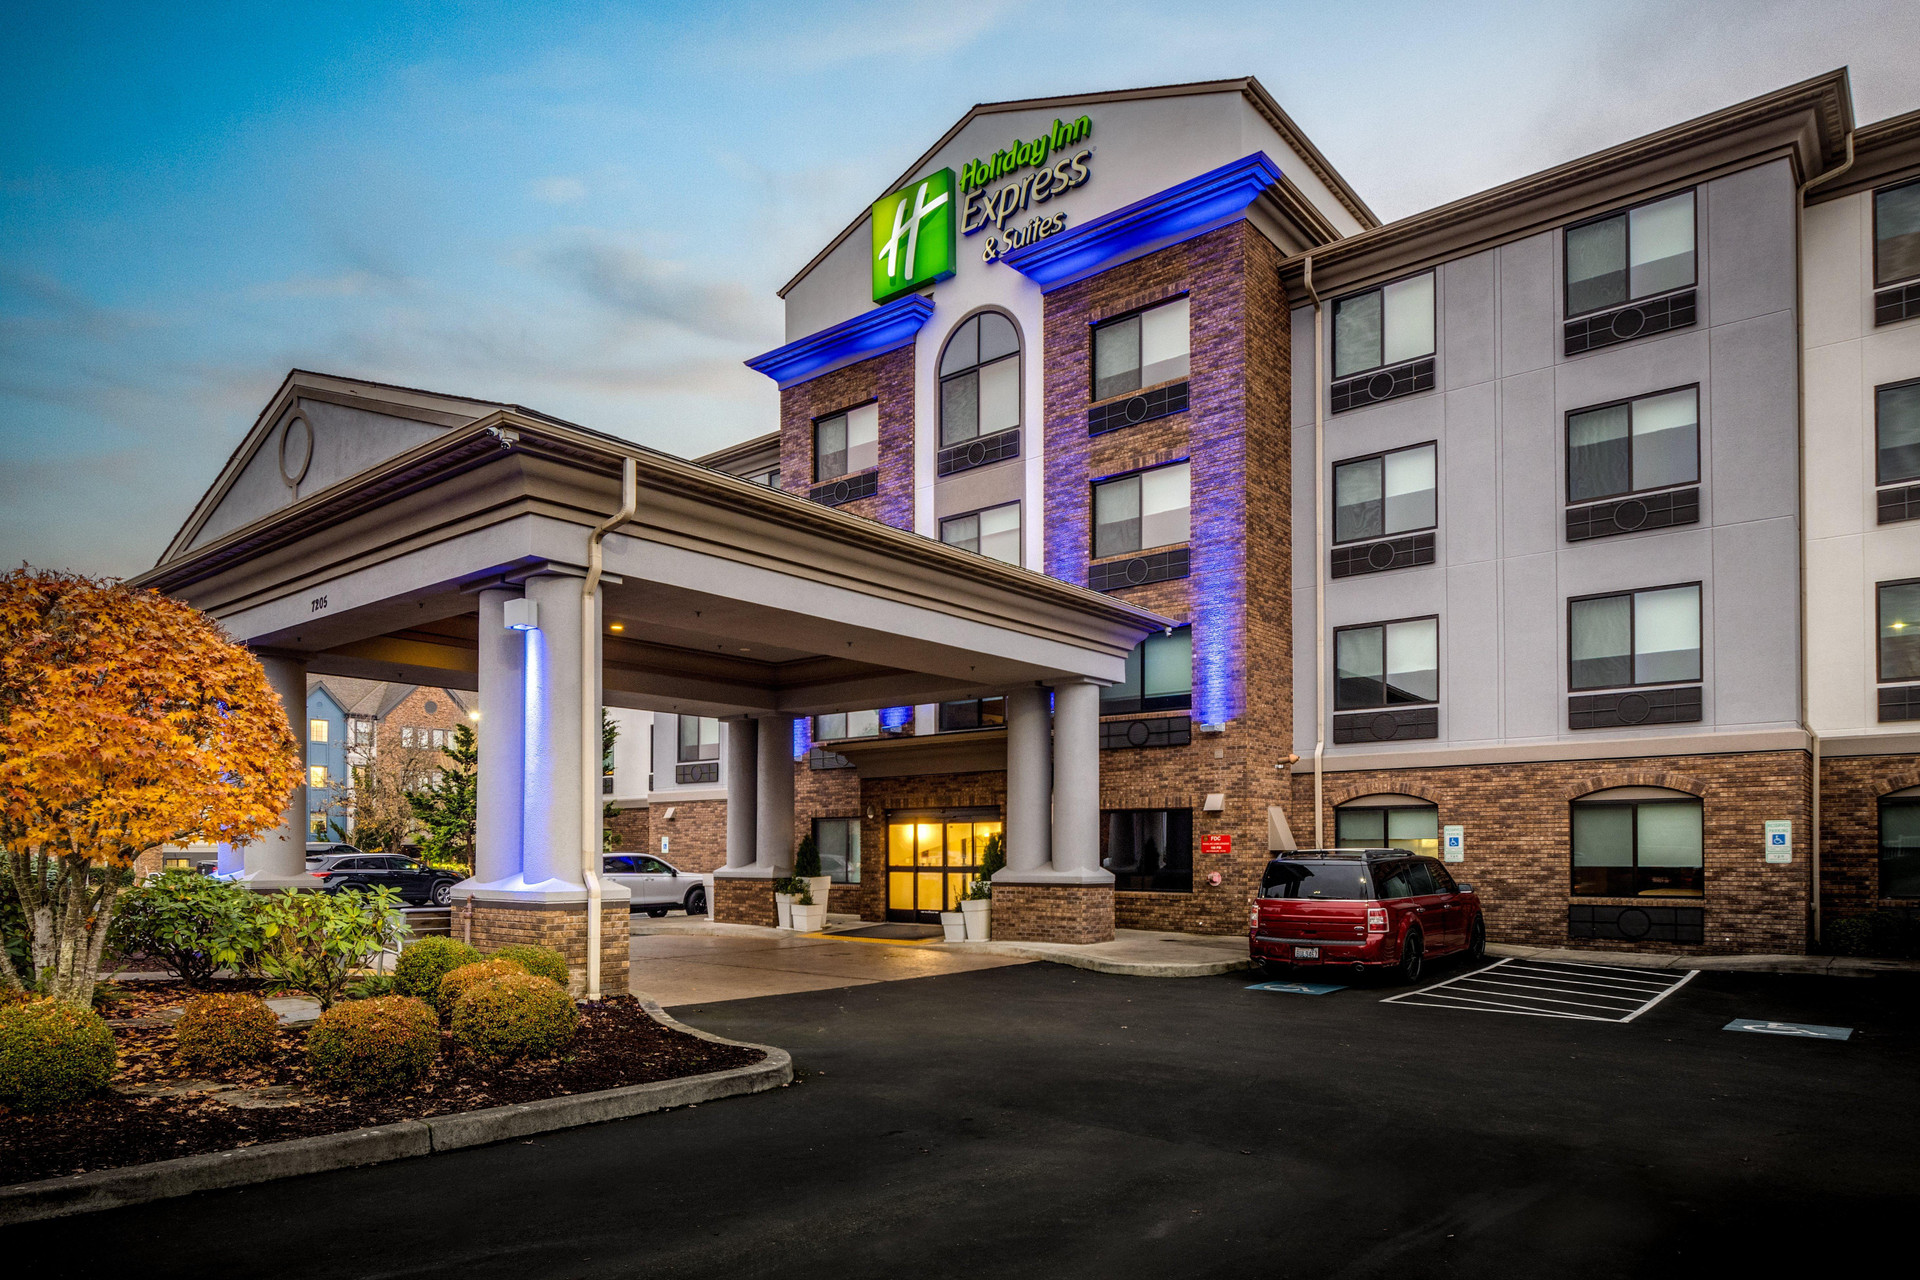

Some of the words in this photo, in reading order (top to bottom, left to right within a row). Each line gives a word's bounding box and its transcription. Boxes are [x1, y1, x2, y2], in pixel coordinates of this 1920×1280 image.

[959, 134, 1050, 193] Holiday
[1050, 115, 1092, 150] Inn
[960, 150, 1093, 236] Express
[982, 236, 999, 264] &
[1000, 211, 1068, 255] Suites
[311, 595, 327, 612] 7205
